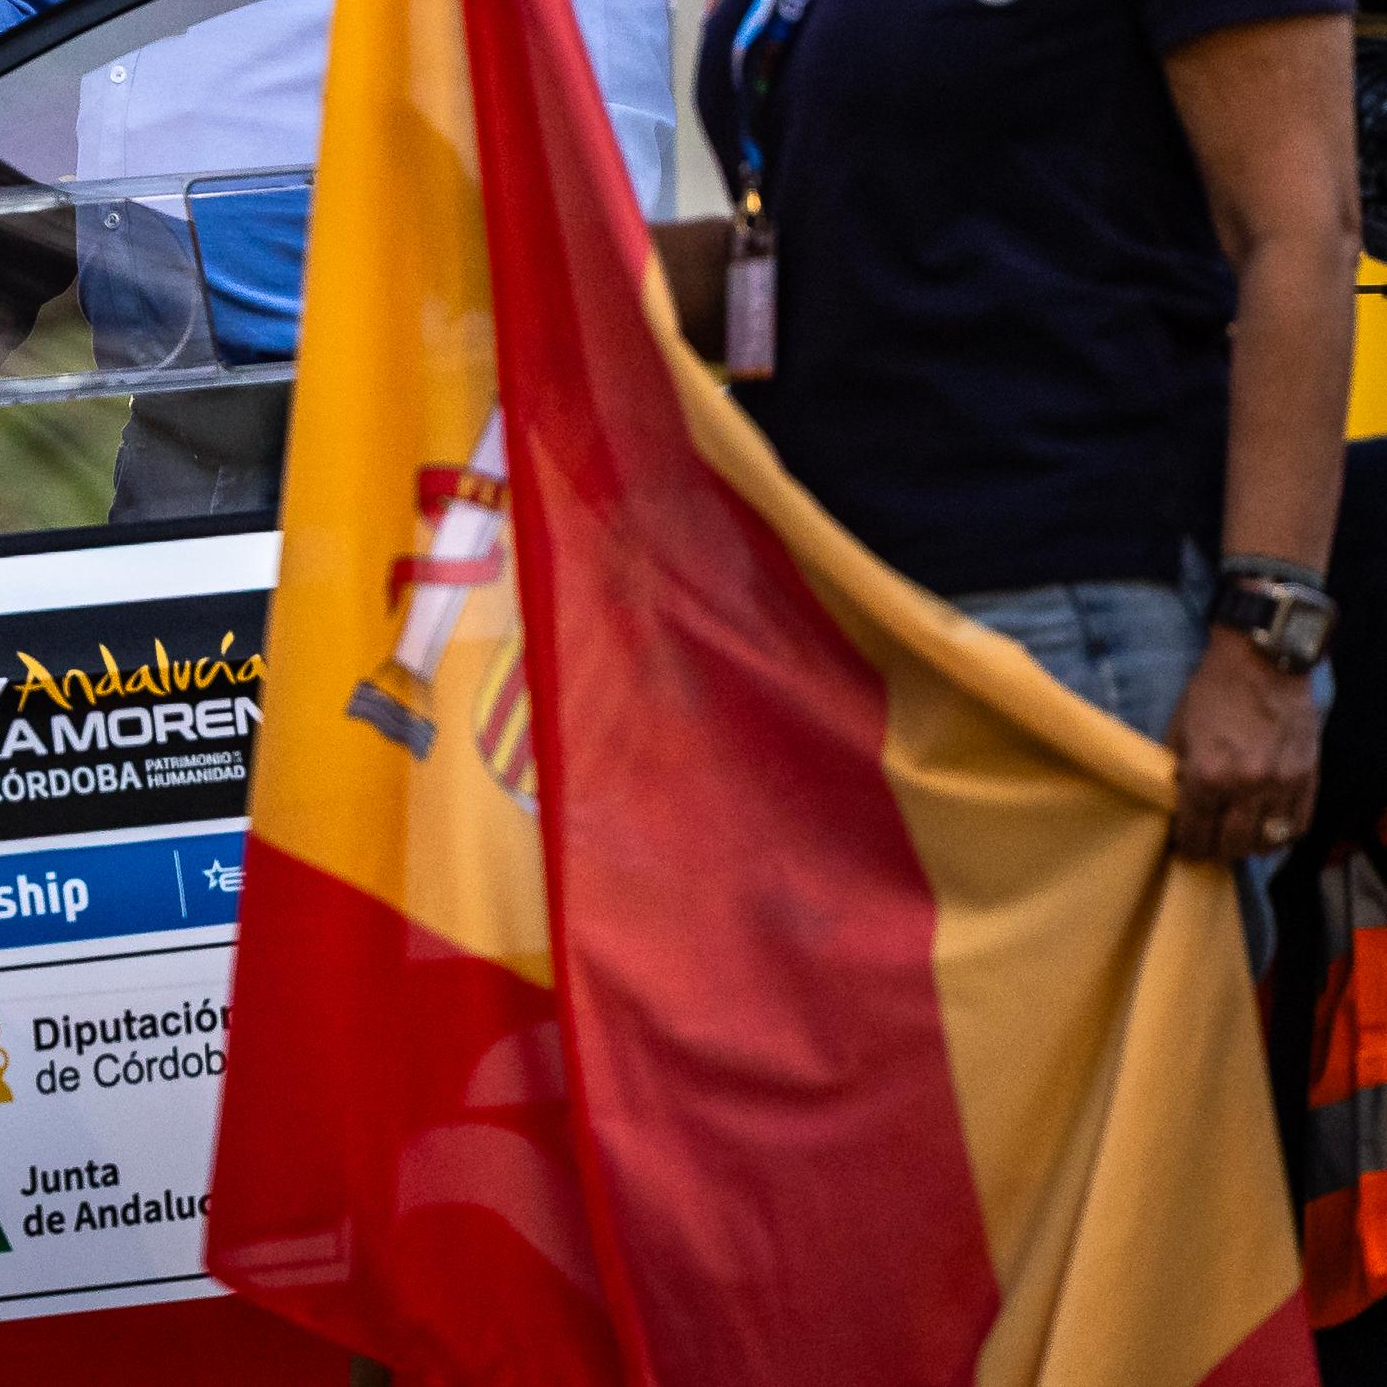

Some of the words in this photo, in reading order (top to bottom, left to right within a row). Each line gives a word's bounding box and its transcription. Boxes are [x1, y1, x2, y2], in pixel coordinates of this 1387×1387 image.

[14, 630, 268, 712] Andalucía
[49, 696, 266, 756] MOREN
[147, 764, 247, 789] HUMANIDAD
[35, 1059, 81, 1095] de
[93, 1041, 227, 1089] Córdob
[20, 1160, 120, 1197] Junta
[23, 1203, 66, 1238] de
[74, 1189, 213, 1234] Andaluc
